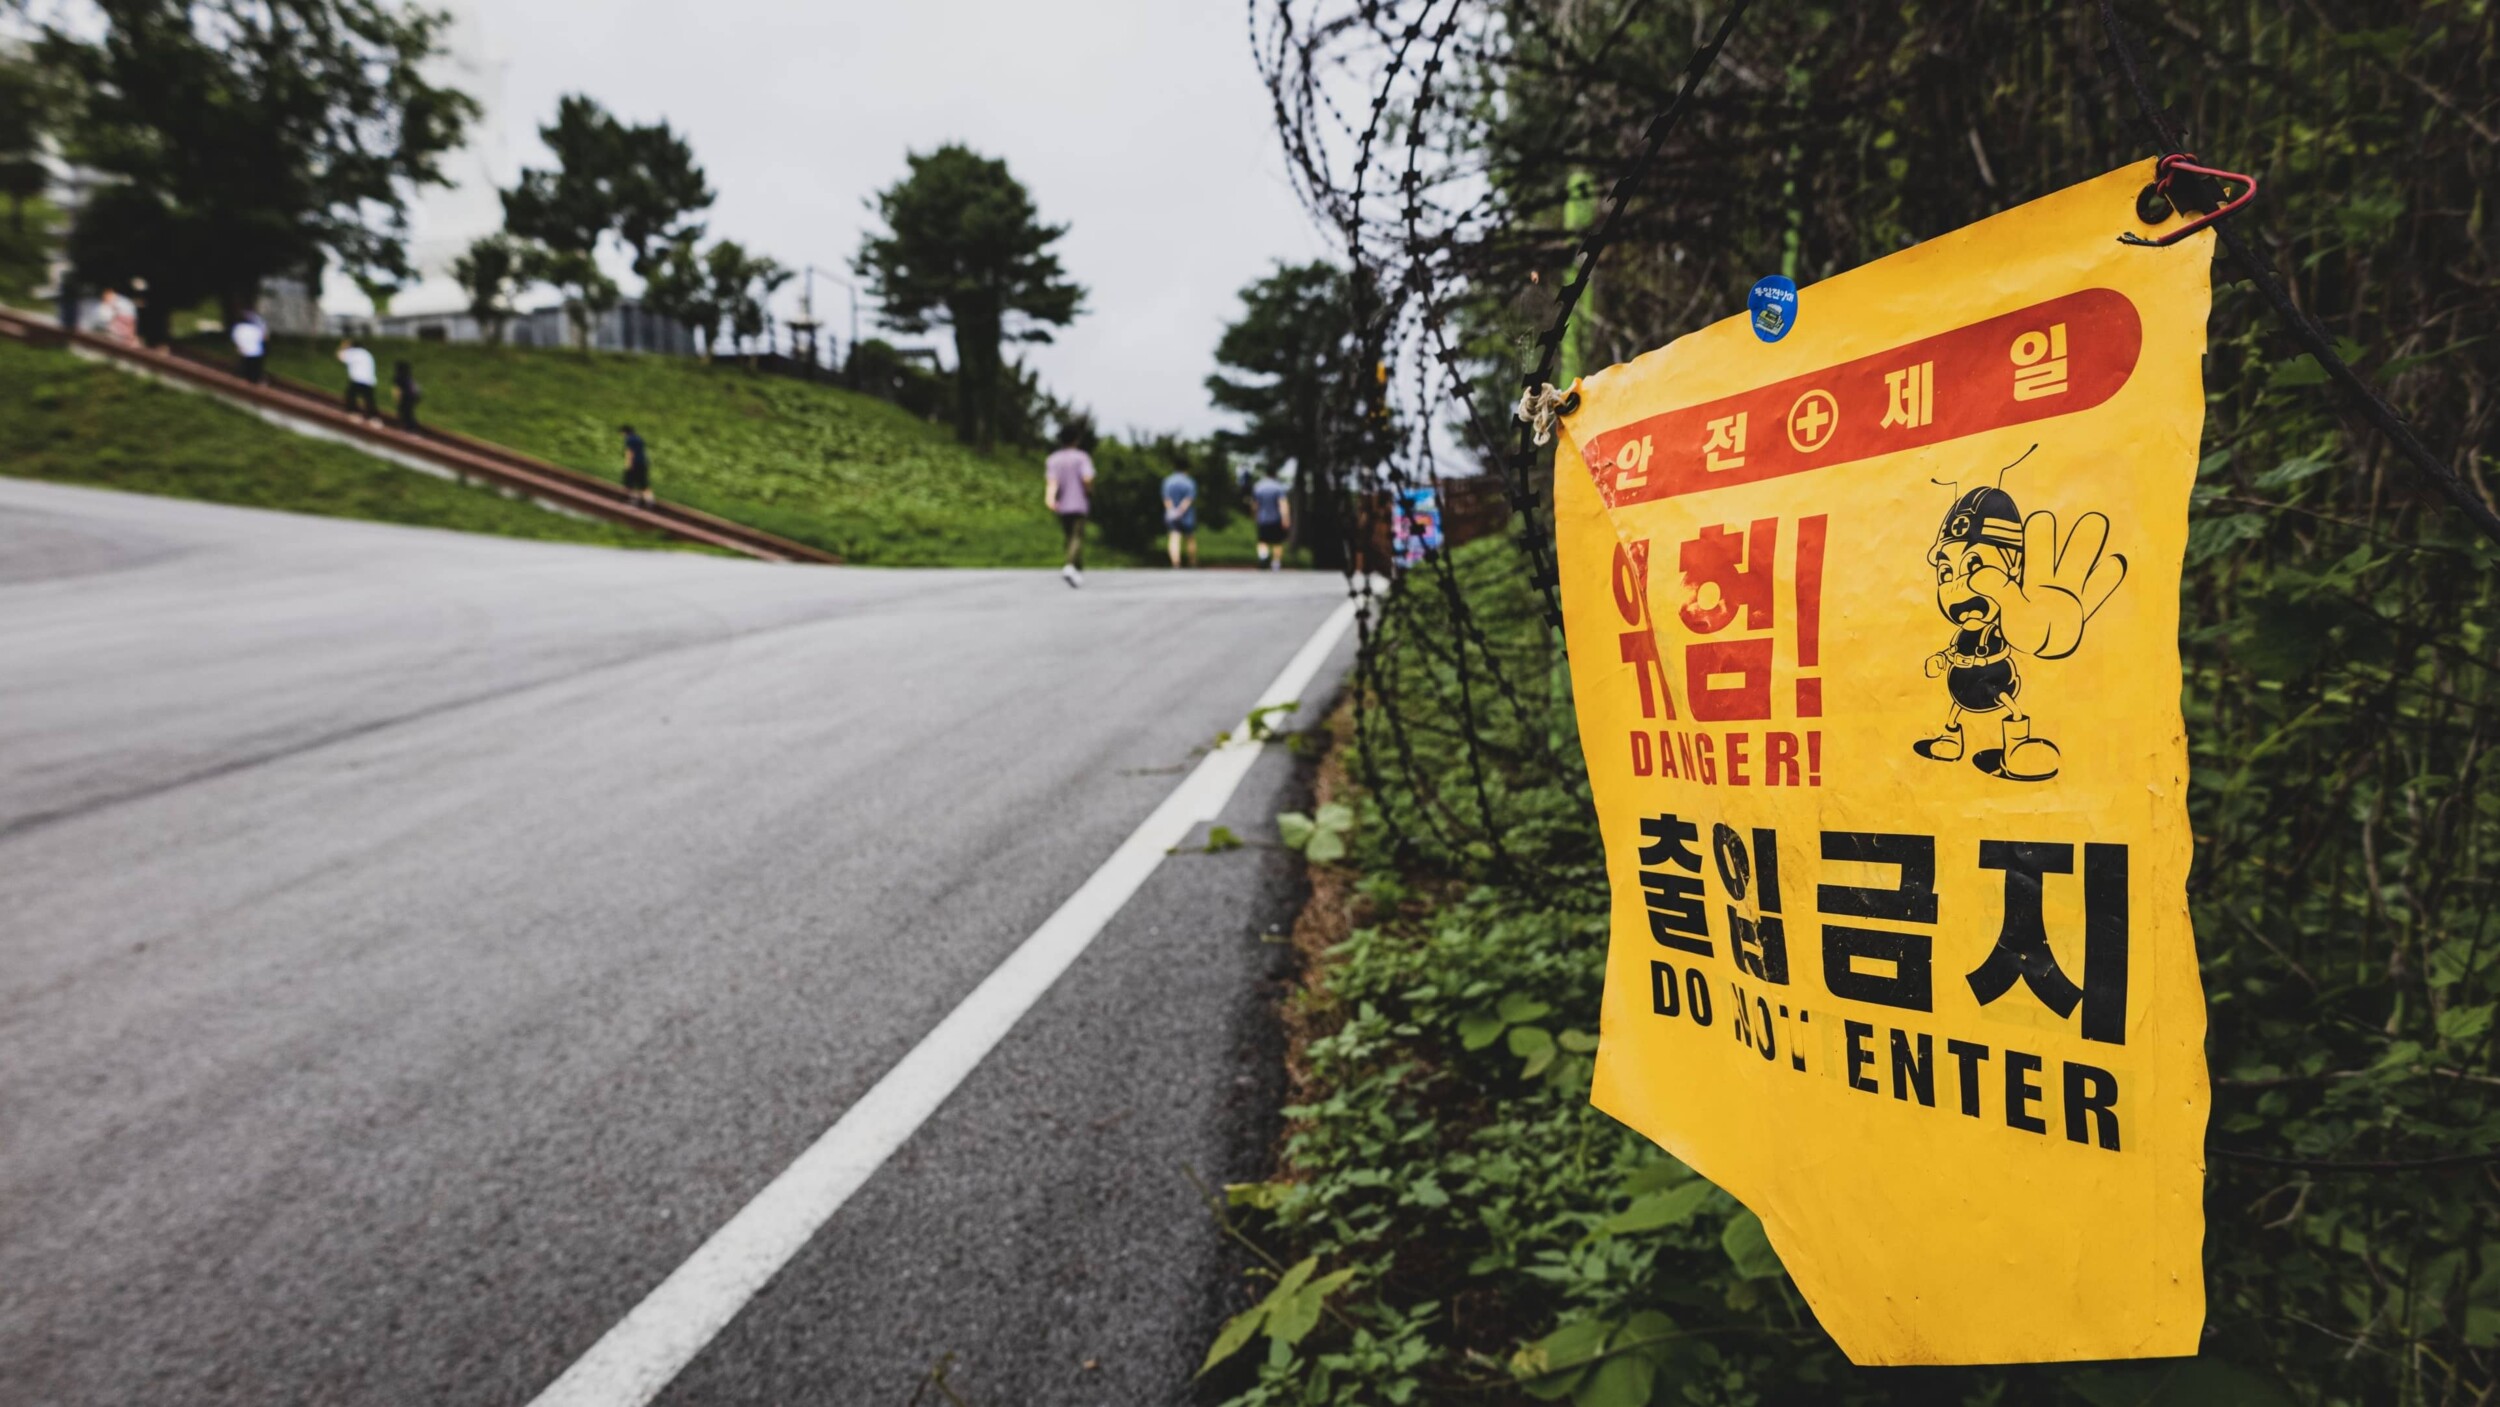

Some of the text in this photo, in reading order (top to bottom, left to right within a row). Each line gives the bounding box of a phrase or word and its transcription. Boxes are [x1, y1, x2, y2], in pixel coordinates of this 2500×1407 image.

[1612, 514, 1827, 722] 위험!
[1630, 730, 1821, 787] DANGER!
[1650, 960, 1713, 1027] DO
[1844, 1019, 2121, 1152] ENTER
